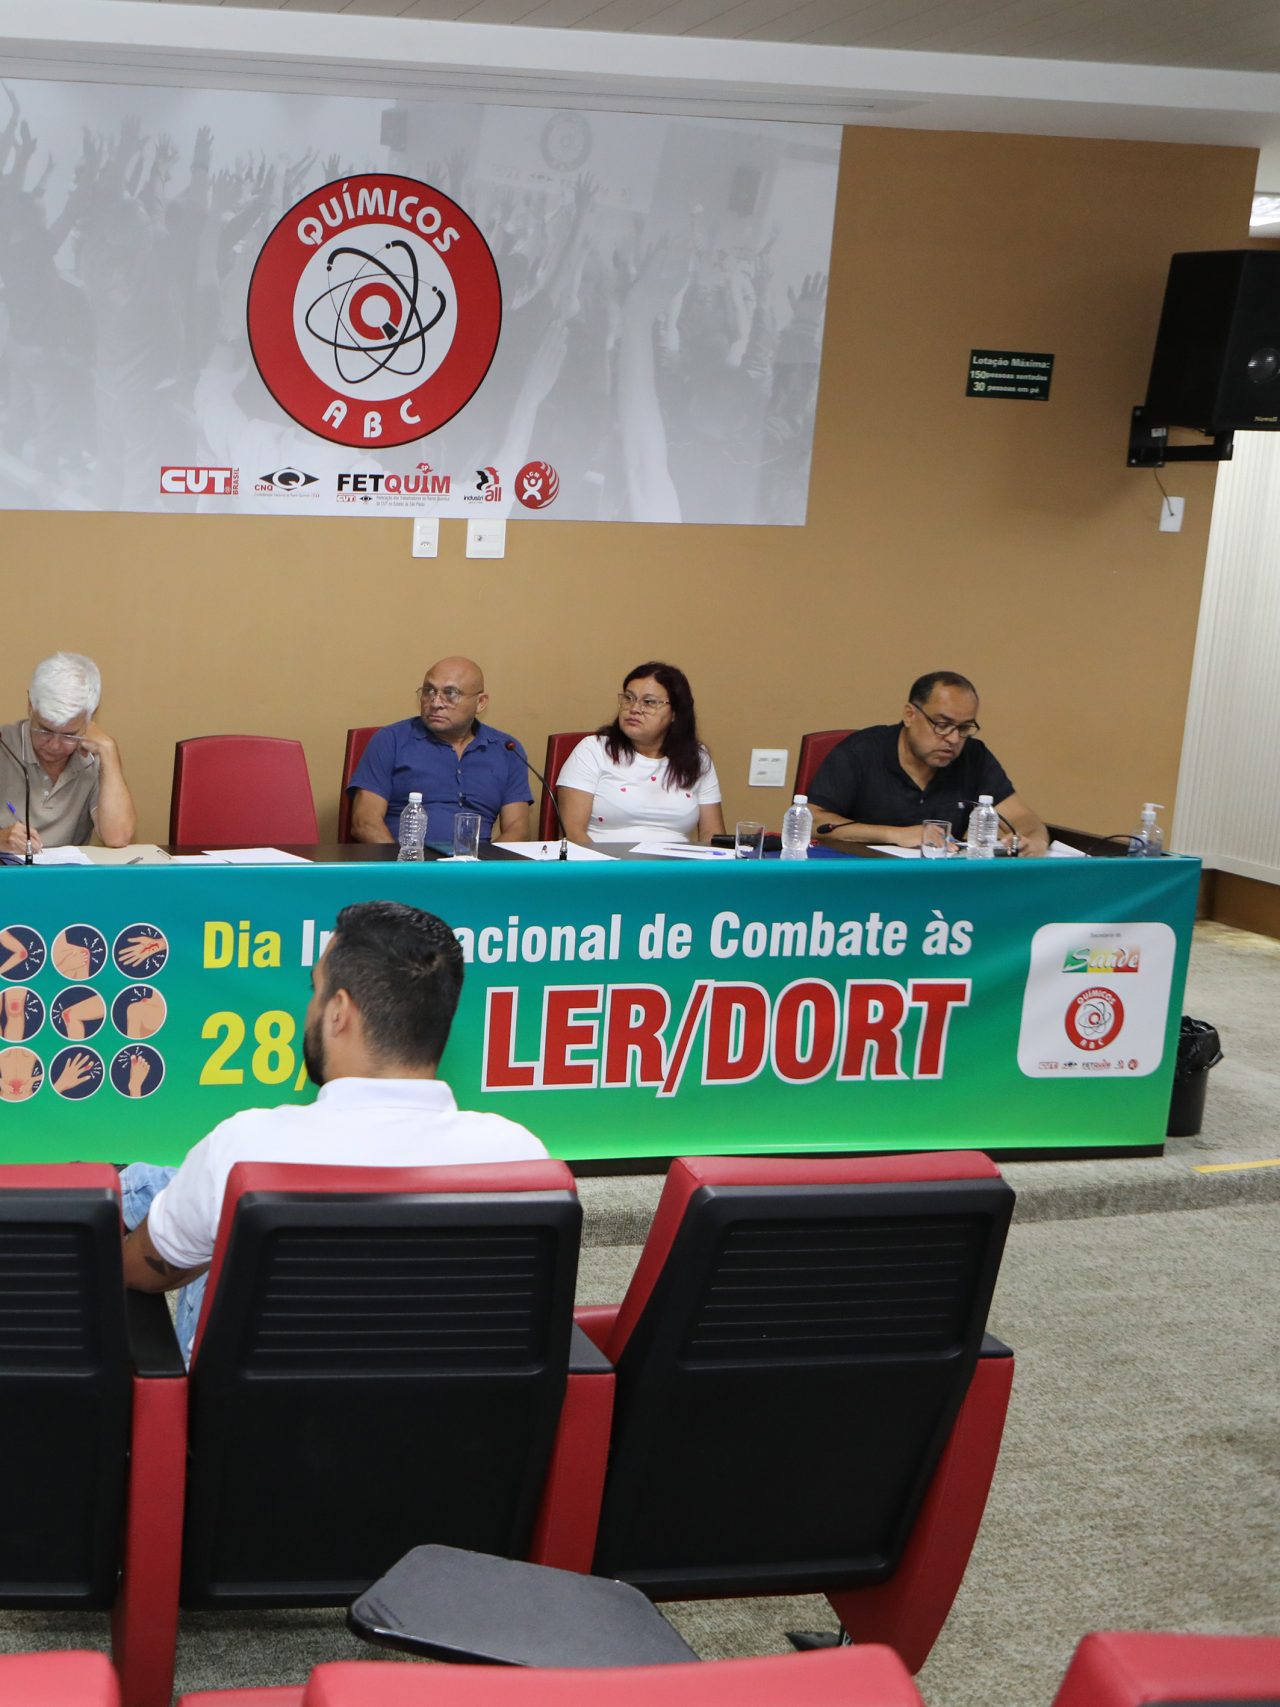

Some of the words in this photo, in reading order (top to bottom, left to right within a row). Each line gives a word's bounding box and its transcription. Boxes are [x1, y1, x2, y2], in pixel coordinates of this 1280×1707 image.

[297, 183, 460, 252] QUÍMICOS
[972, 356, 1009, 367] Lotação
[973, 381, 986, 391] 30
[161, 469, 231, 493] CUT
[232, 468, 240, 495] BRASIL
[203, 919, 282, 969] Dia
[638, 913, 693, 960] de
[710, 911, 908, 958] Combate
[922, 909, 974, 957] às
[481, 977, 973, 1098] LER/DORT
